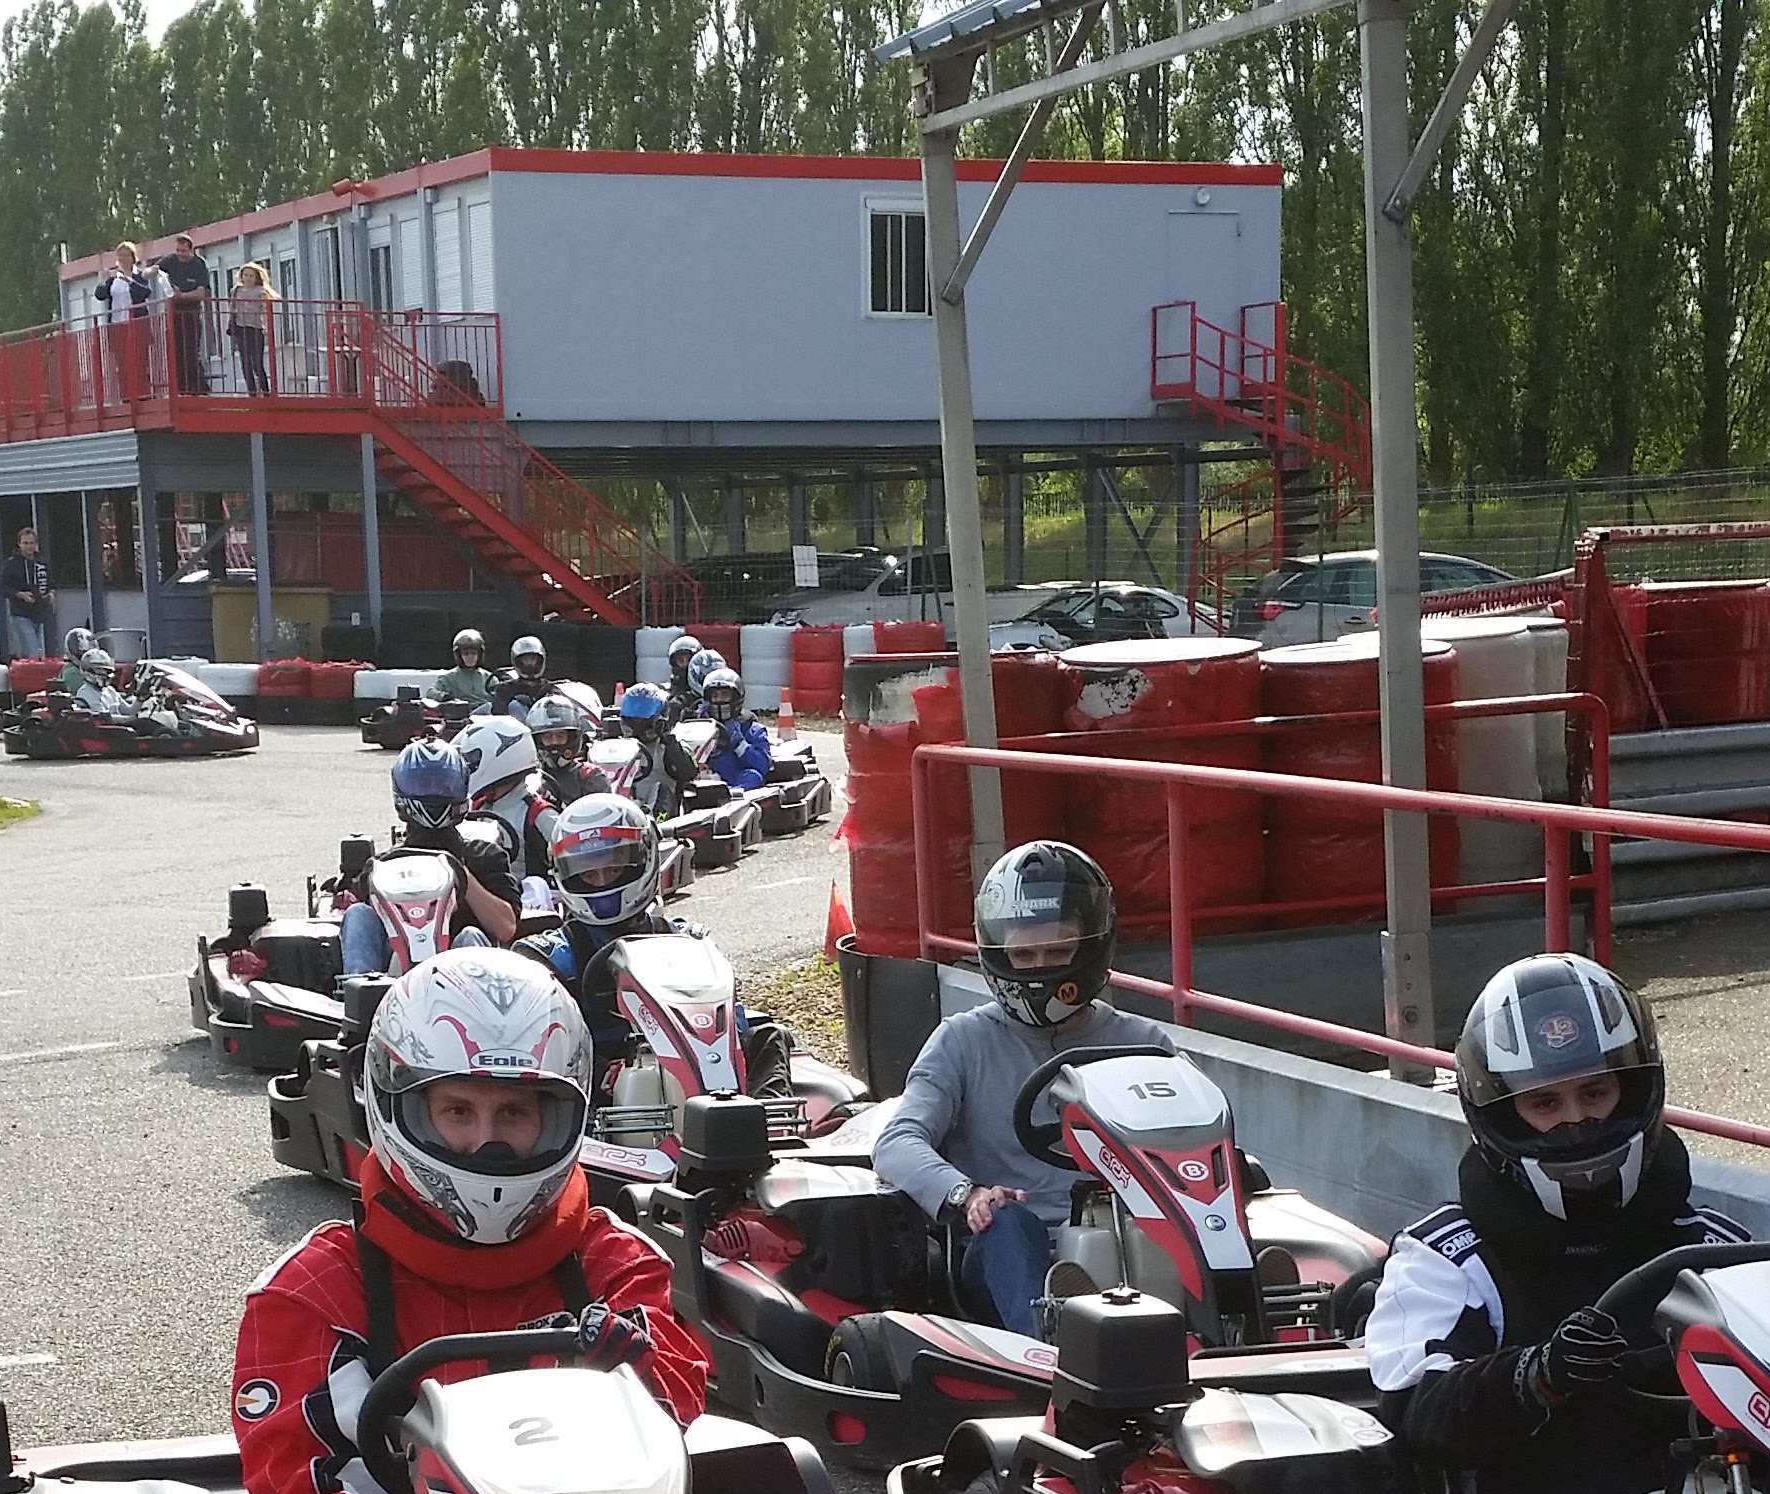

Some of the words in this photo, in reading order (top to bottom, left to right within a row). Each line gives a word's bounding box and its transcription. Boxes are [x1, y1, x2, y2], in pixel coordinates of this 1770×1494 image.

[478, 1055, 533, 1068] Eole
[1127, 1082, 1177, 1100] 15
[1442, 1231, 1477, 1257] OMP
[508, 1416, 560, 1446] 2
